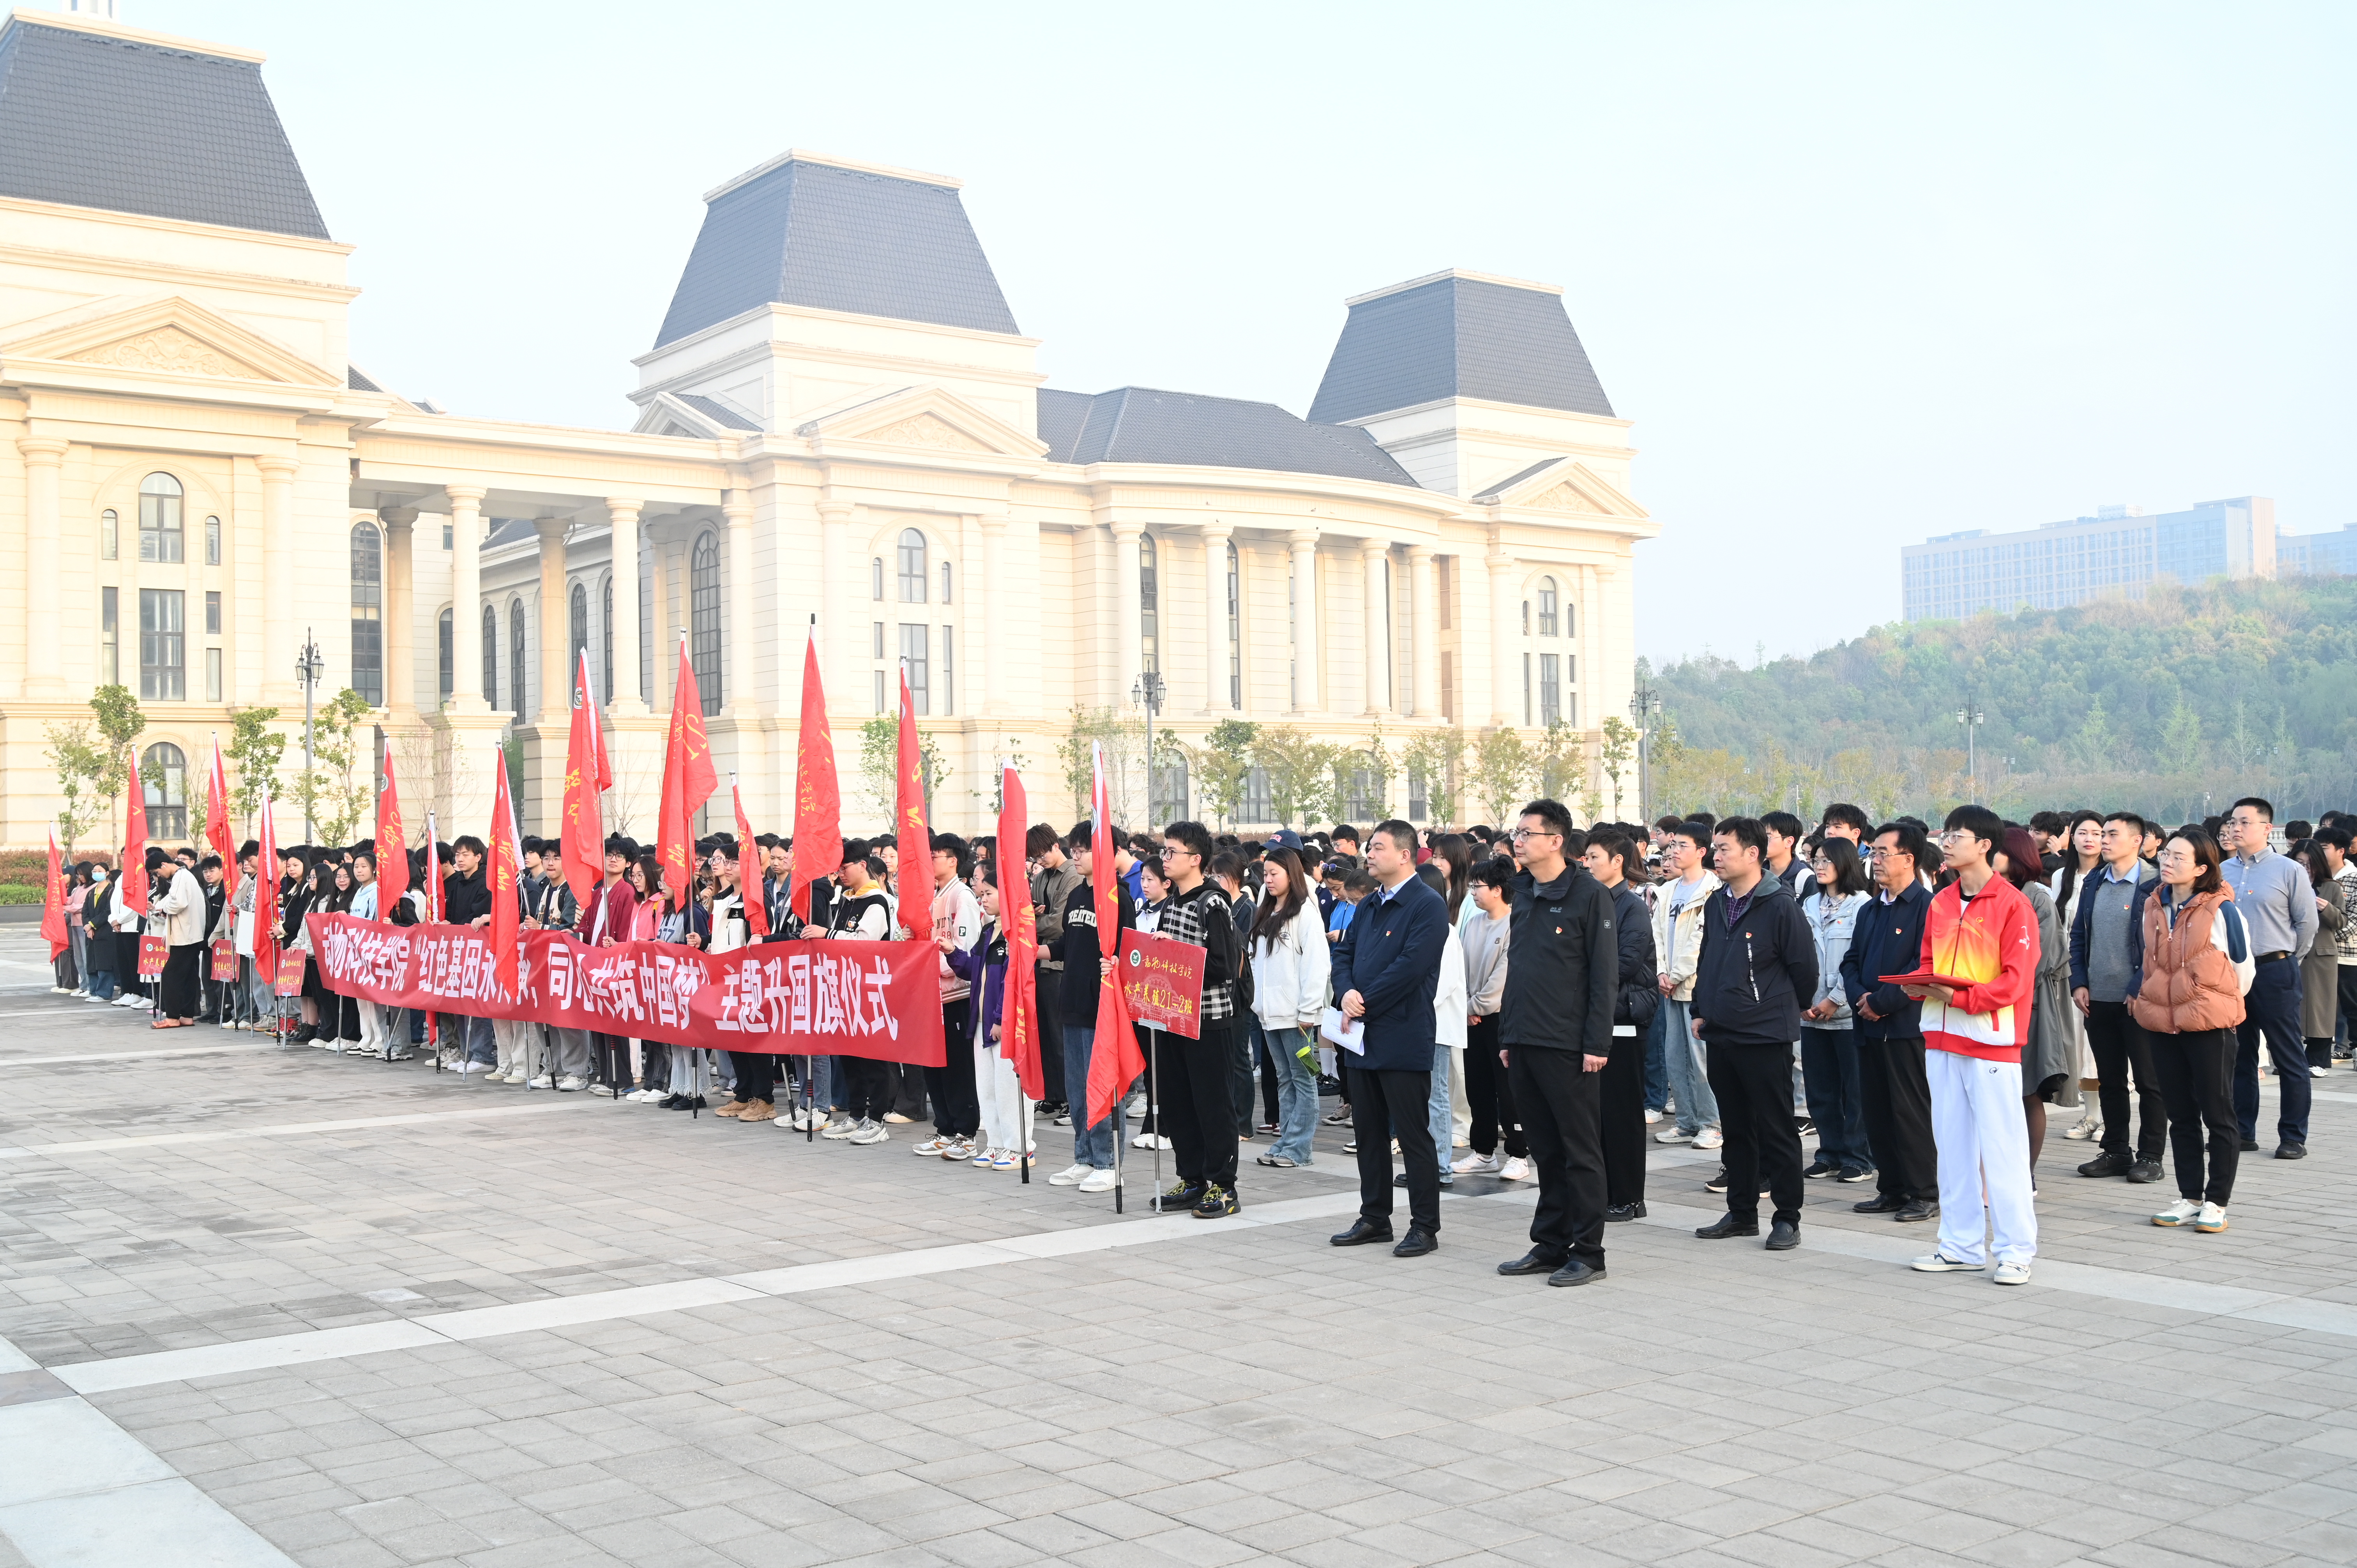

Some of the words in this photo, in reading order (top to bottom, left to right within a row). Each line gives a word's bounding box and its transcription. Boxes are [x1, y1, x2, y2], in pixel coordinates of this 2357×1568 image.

[959, 927, 966, 936] P
[1124, 980, 1192, 1015] 水产养殖21-2班
